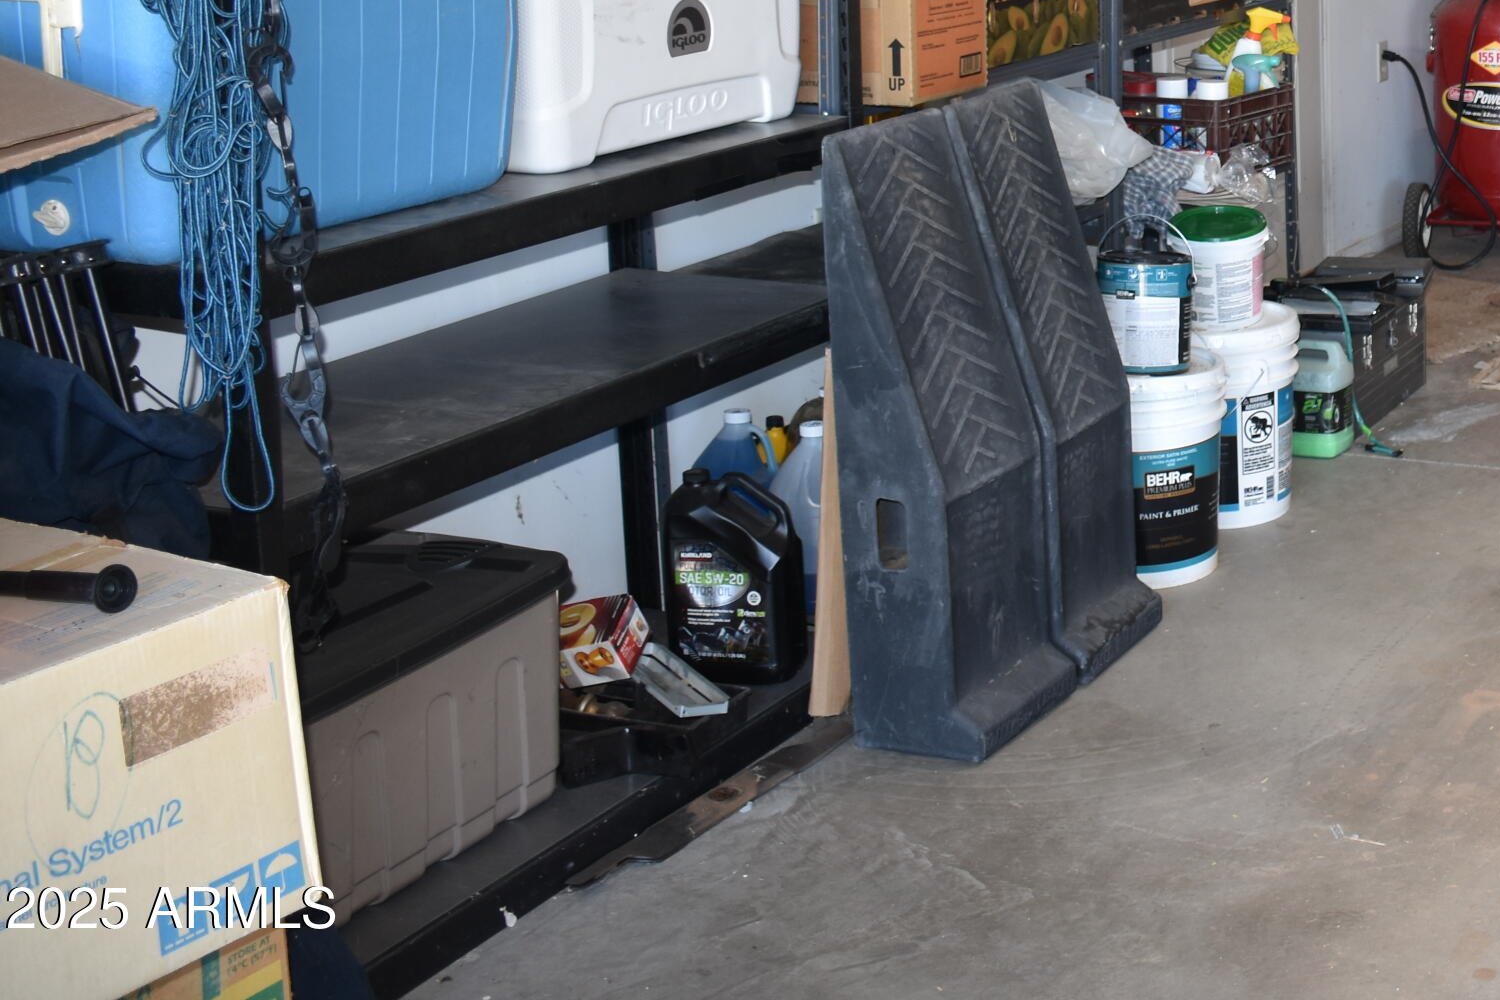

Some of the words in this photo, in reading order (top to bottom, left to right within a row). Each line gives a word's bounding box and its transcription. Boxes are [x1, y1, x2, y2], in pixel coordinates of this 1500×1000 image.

[672, 33, 706, 50] IGLOO
[1478, 52, 1495, 64] 155
[889, 77, 906, 92] UP
[645, 90, 728, 131] IGLOO
[1146, 471, 1180, 487] BEHR
[1139, 511, 1163, 520] PAINT
[1173, 504, 1200, 517] PRIMER
[680, 573, 703, 584] SAE
[705, 573, 744, 585] 5W-20
[0, 861, 40, 893] nal
[49, 799, 184, 877] System/2
